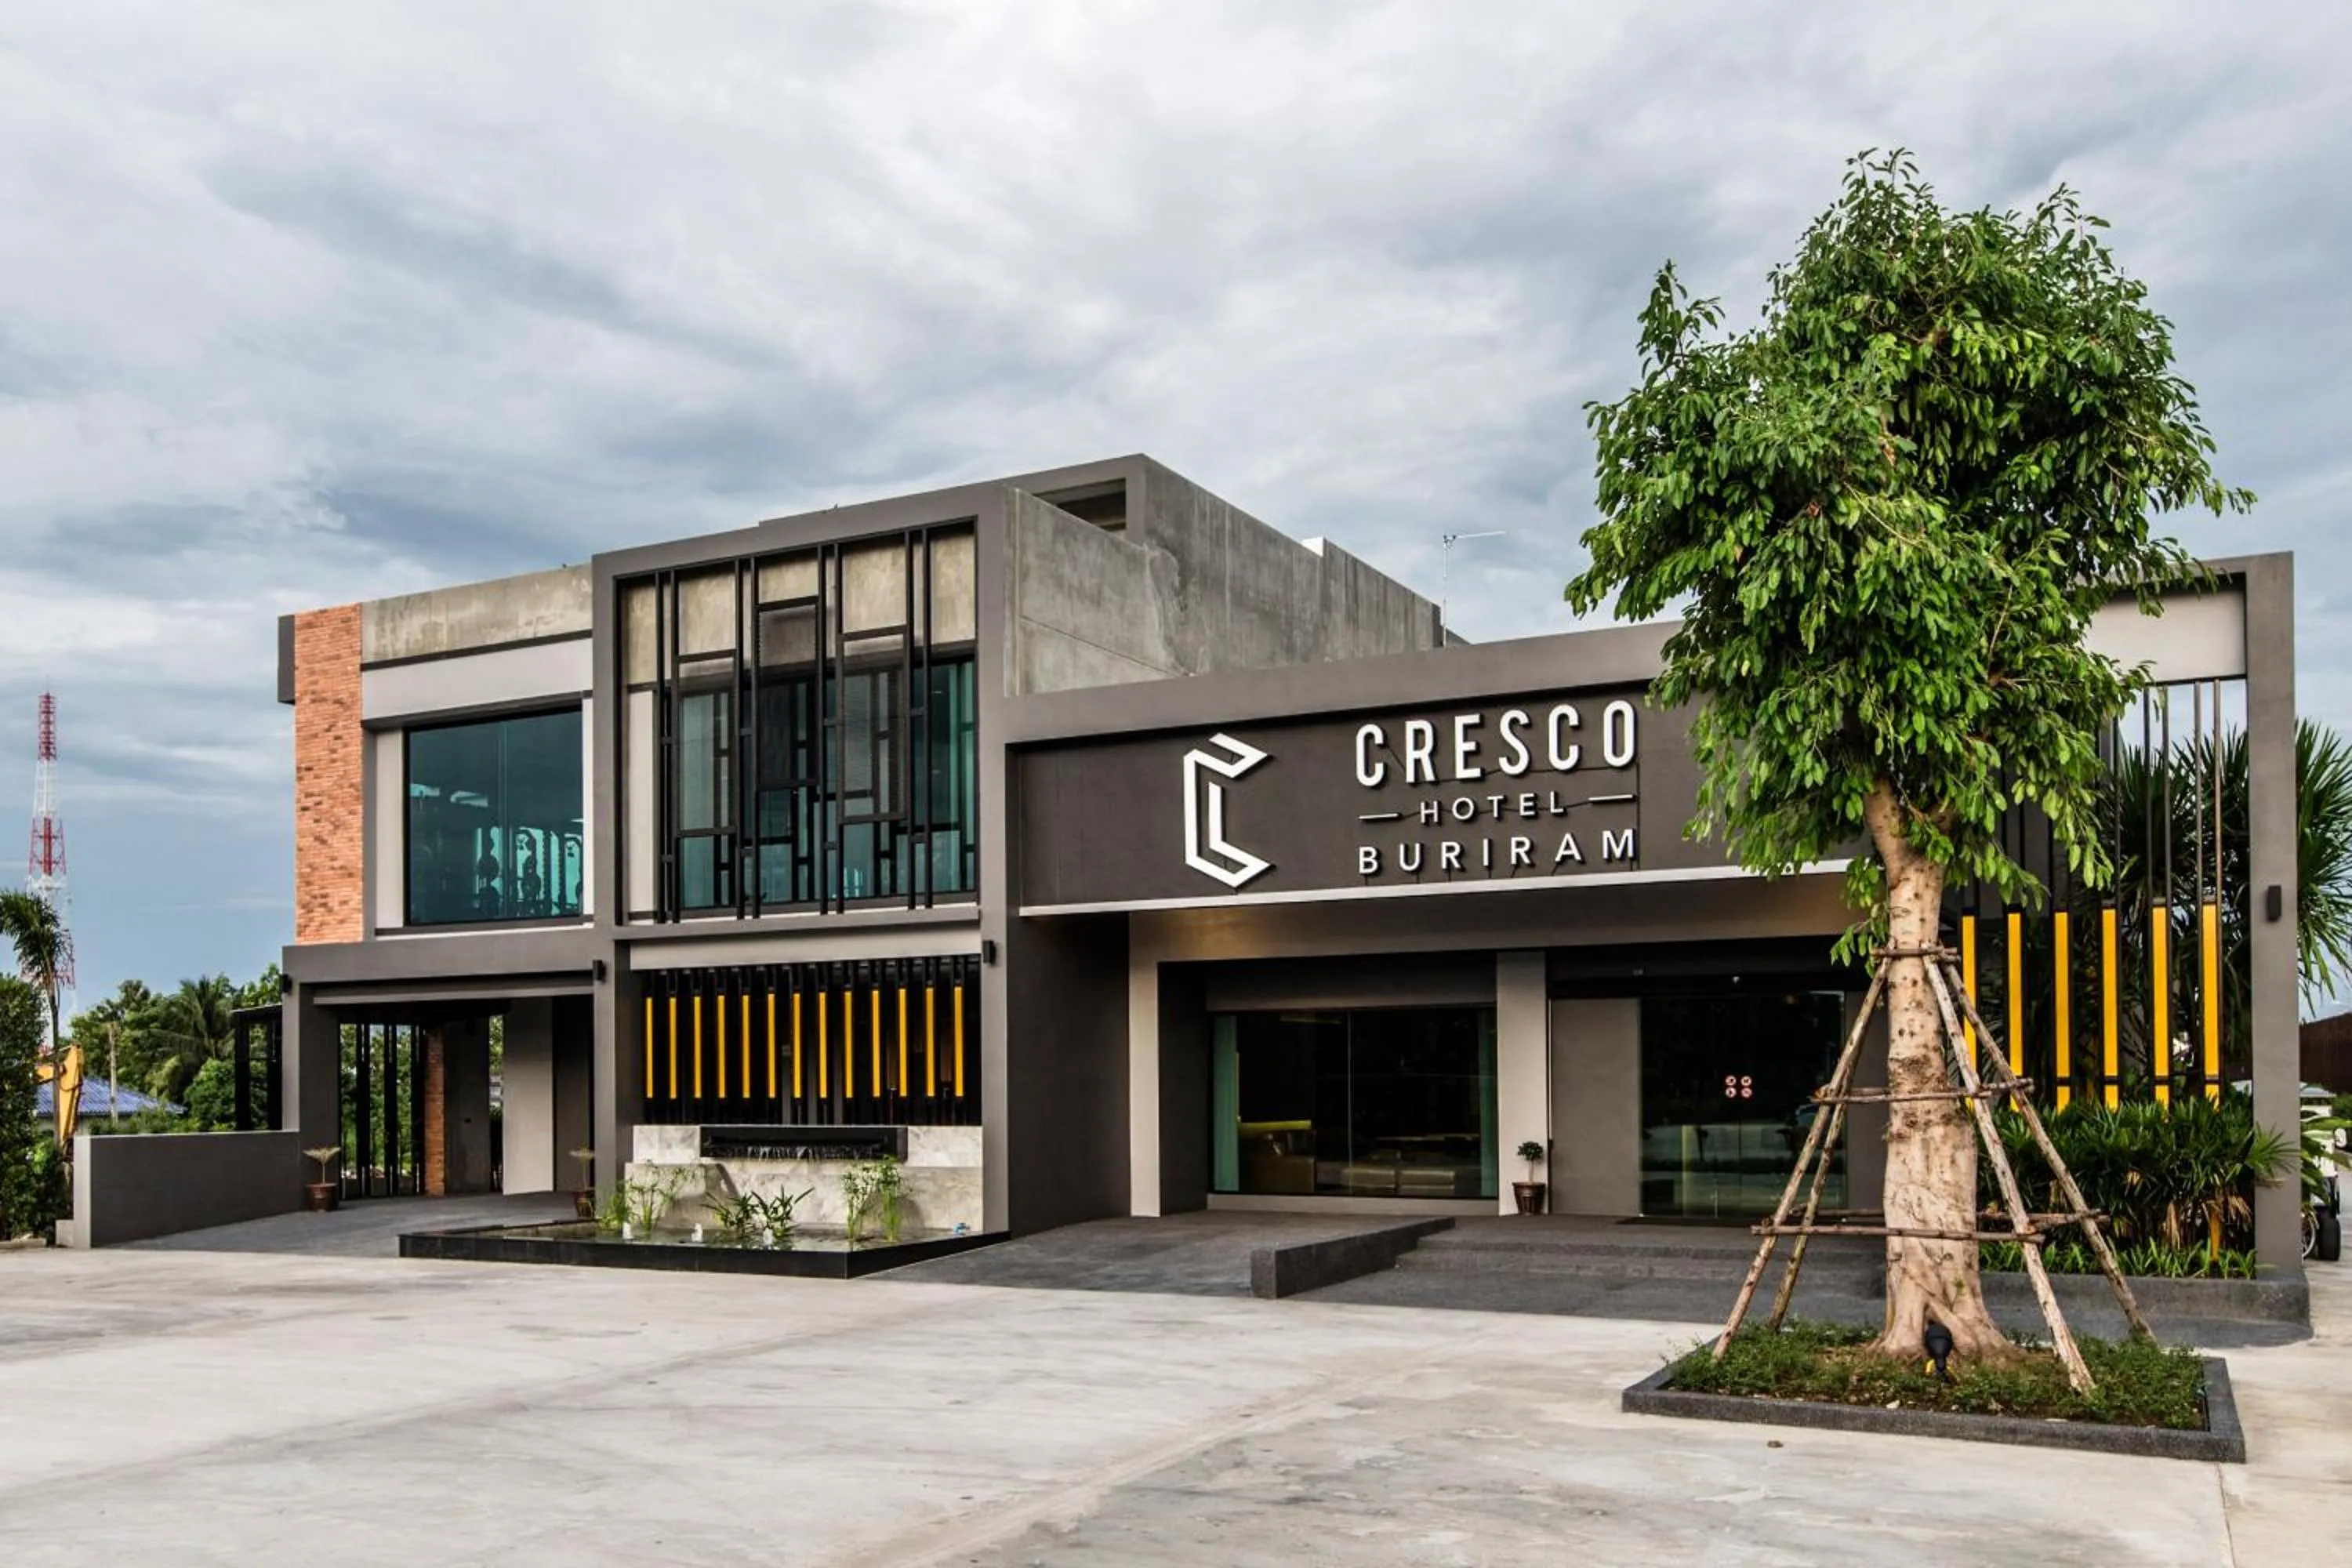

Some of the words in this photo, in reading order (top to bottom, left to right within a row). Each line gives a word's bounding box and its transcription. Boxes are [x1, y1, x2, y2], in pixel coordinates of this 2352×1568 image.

[1356, 700, 1636, 787] CRESCO
[1420, 790, 1565, 823] HOTEL
[1359, 828, 1635, 875] BURIRAM
